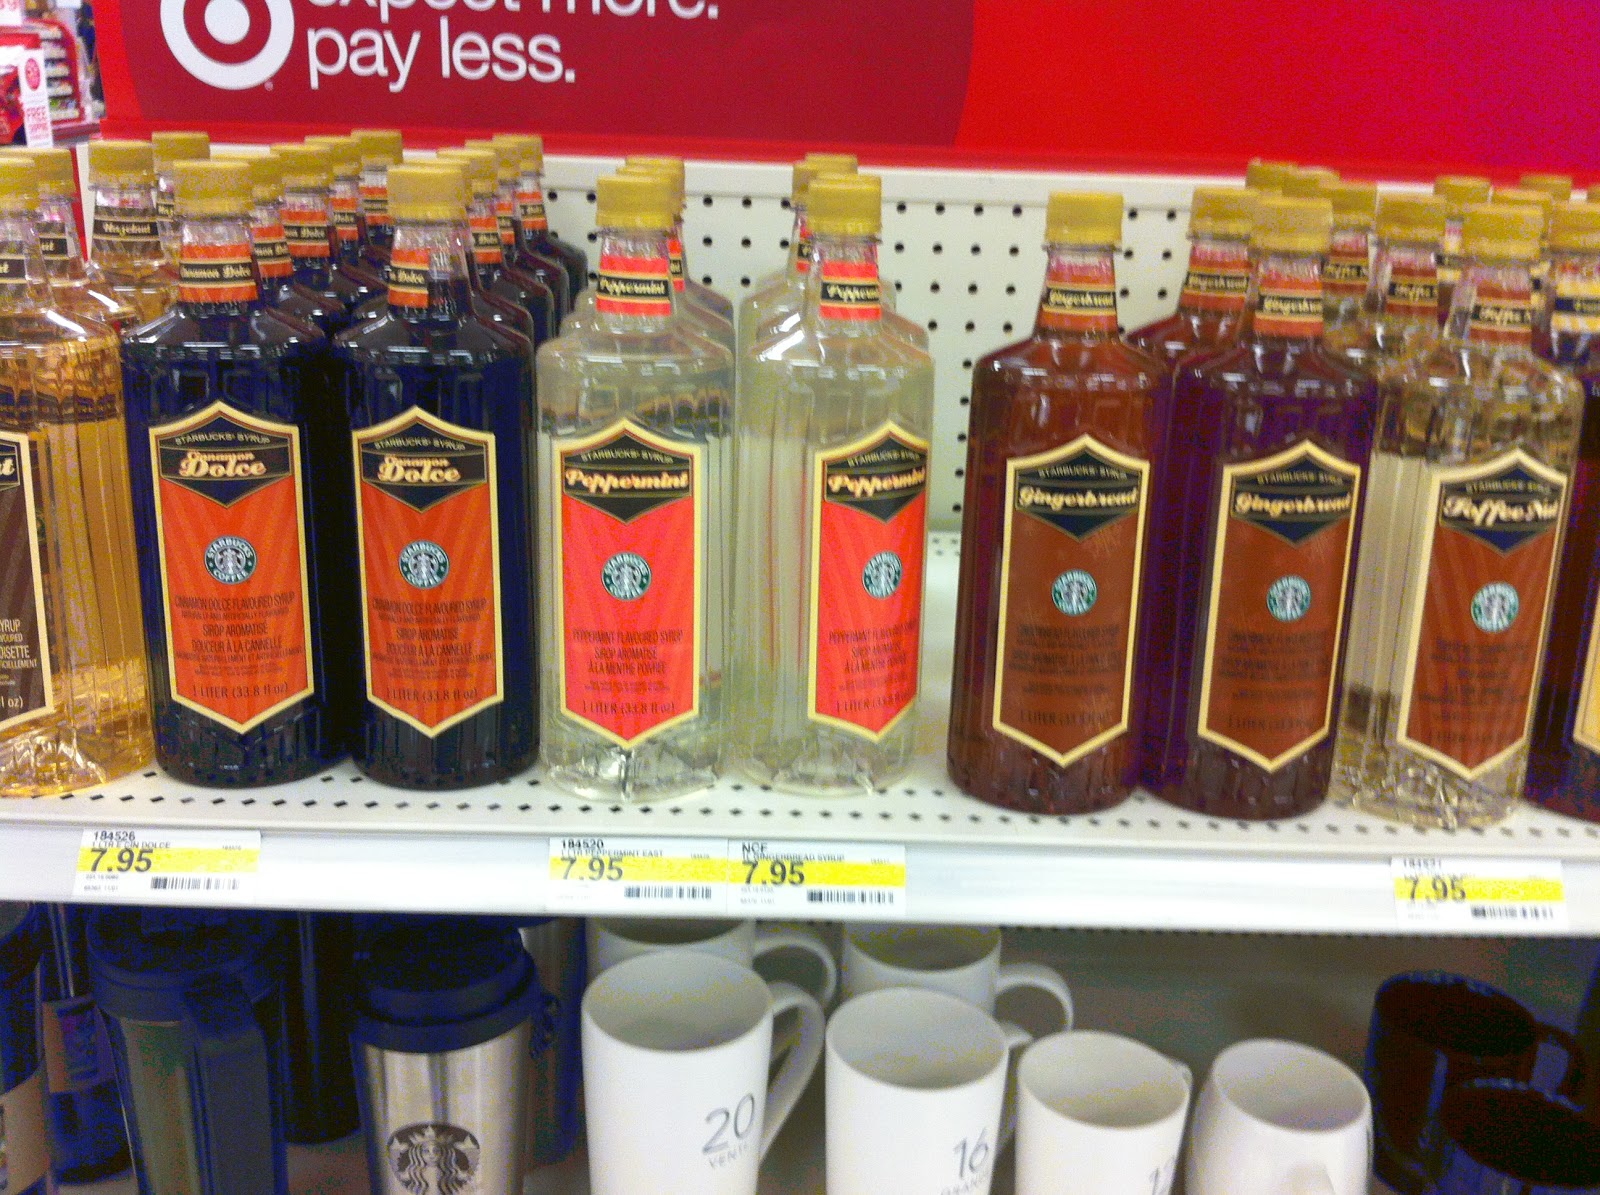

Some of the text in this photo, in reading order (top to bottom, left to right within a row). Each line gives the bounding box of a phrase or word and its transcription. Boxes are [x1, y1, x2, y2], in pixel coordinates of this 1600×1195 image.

[307, 15, 576, 93] pay less.
[179, 457, 268, 478] Dolce
[377, 461, 462, 483] Dolce
[564, 467, 690, 495] Peppermint
[1018, 485, 1138, 511] Gingerbread
[94, 830, 136, 842] 184526
[91, 848, 154, 873] 7.95
[560, 856, 624, 882] 7.95
[742, 859, 805, 886] 7.95
[702, 1092, 755, 1156] 20
[952, 1126, 990, 1180] 16
